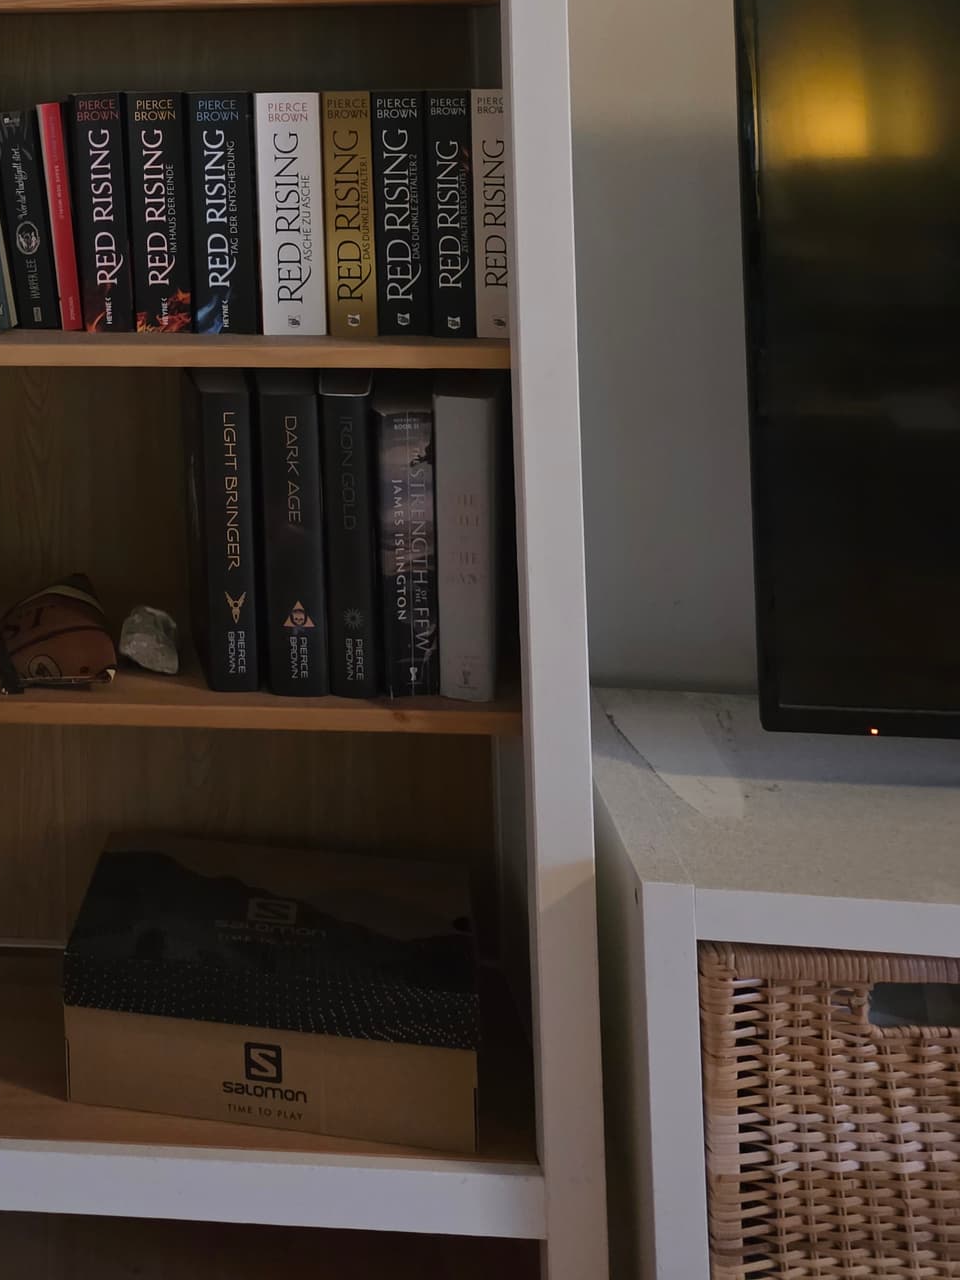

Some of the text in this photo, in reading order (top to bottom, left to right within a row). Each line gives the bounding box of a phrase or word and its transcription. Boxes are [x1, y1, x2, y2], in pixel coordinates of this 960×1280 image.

[76, 111, 119, 121] BROWN
[78, 99, 115, 110] PIERCE
[134, 111, 176, 121] BROWN
[136, 99, 173, 110] PIERCE
[196, 111, 239, 121] BROWN
[198, 99, 236, 110] PIERCE
[327, 99, 368, 108] PIERCE
[327, 109, 368, 119] BROWN
[376, 98, 417, 108] PIERCE
[376, 108, 418, 119] BROWN
[166, 164, 175, 195] FEINDE
[226, 141, 239, 255] TAG DER ENTSCHEIDUNG
[88, 128, 124, 286] RED RISING
[141, 129, 175, 286] RED RISING
[203, 129, 237, 288] RED RISING
[273, 132, 312, 304] RED RISING
[300, 175, 312, 261] ASCHE ASCHE
[332, 129, 372, 302] RED RISING
[382, 128, 422, 301] RED RISING
[435, 140, 470, 289] RED RISING
[482, 140, 508, 289] RED RISING
[25, 258, 37, 273] LEE
[284, 415, 302, 523] DARK AGE
[223, 411, 240, 570] LIGHT BRINGER
[409, 467, 428, 584] STRENGTH
[391, 478, 407, 621] JAMES ISLINGTON
[228, 631, 236, 673] BROWN
[237, 631, 246, 673] PIERCE
[289, 636, 299, 679] BROWN
[299, 636, 308, 678] PIERCE
[222, 1081, 307, 1104] salomon
[227, 1104, 303, 1121] TIME TO PLAY
